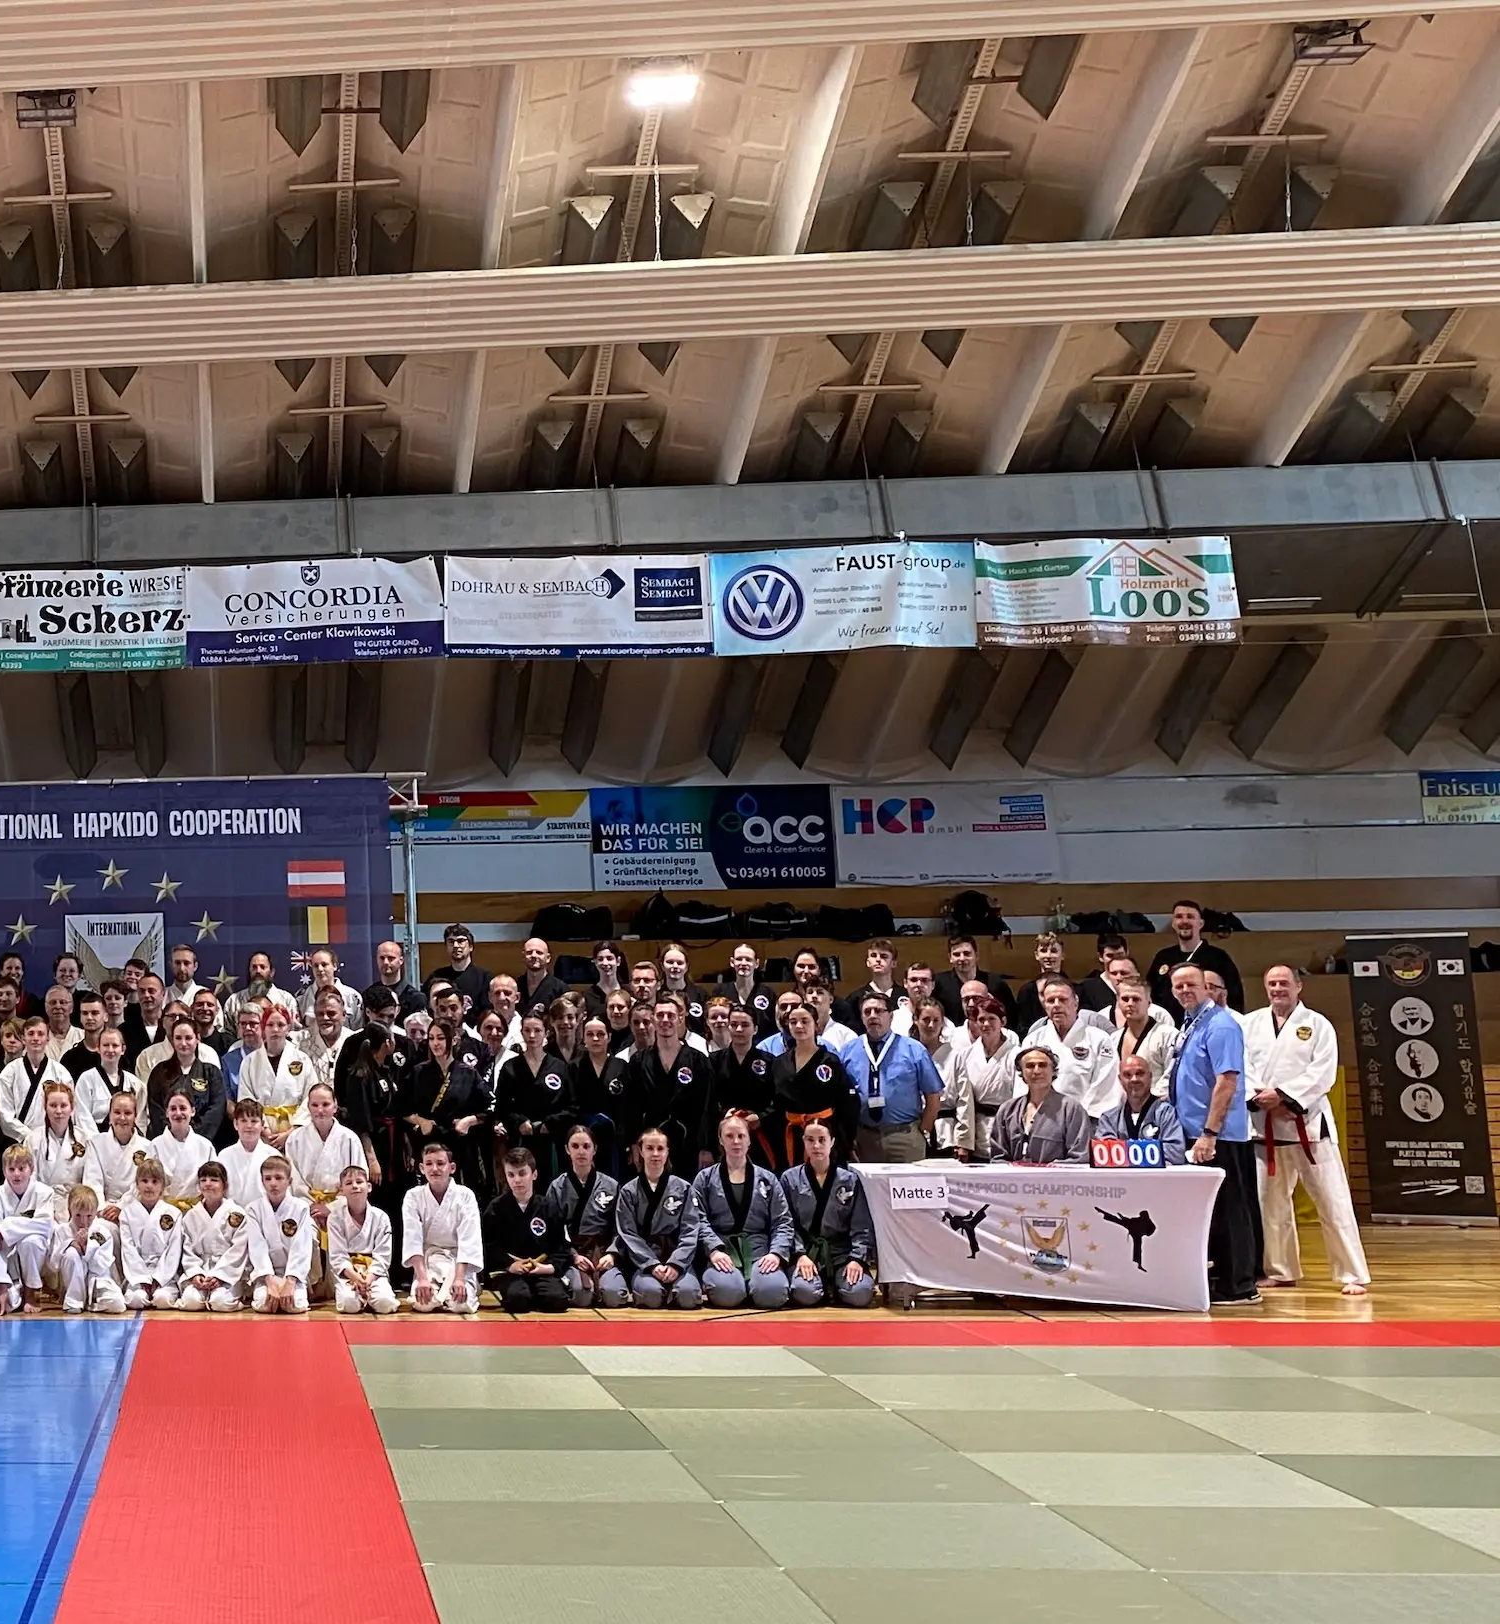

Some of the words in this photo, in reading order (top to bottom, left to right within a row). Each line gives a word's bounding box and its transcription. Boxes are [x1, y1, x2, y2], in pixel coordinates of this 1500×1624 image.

[1044, 564, 1069, 572] Garten
[451, 581, 515, 594] DOHRAU
[518, 583, 529, 594] &
[533, 580, 605, 594] SEMBACH
[641, 576, 694, 587] SEMBACH
[1121, 578, 1189, 589] Holzmarkt
[641, 587, 694, 598] SEMBACH
[224, 585, 403, 613] CONCORDIA
[39, 604, 185, 634] Scherz
[225, 606, 405, 626] Versicherungen
[838, 627, 859, 638] Wir
[860, 624, 891, 638] freuen
[895, 625, 909, 633] uns
[925, 622, 944, 635] Sie!
[1032, 627, 1042, 635] 26
[1145, 624, 1176, 632] Telefon
[42, 637, 92, 647] PARFÜMERIE
[100, 637, 139, 646] KOSMETIK
[147, 635, 185, 645] WELLNESS
[235, 632, 275, 644] Service
[284, 631, 323, 642] Center
[326, 626, 396, 639] Klawikowski
[1179, 633, 1203, 641] 03491
[419, 646, 433, 654] 347
[451, 647, 561, 656] www.dohrau-sembach.de
[842, 798, 935, 834] HCP
[73, 810, 159, 838] HAPKIDO
[169, 807, 301, 836] COOPERATION
[600, 824, 631, 836] WIR
[635, 822, 703, 836] MACHEN
[743, 814, 825, 845] acc
[601, 839, 633, 851] DAS
[638, 837, 668, 850] FÜR
[675, 837, 703, 850] SIE!
[798, 845, 826, 853] Service
[612, 857, 696, 867] Gebäudereinigung
[613, 867, 699, 877] Grünflächenpflege
[739, 867, 777, 878] 03491
[780, 866, 827, 878] 610005
[613, 878, 703, 886] Hausmeisterservice
[87, 919, 142, 937] INTERNATIONAL
[1093, 1143, 1125, 1165] 00
[1128, 1143, 1160, 1165] 00
[893, 1187, 933, 1199] Matte
[937, 1187, 945, 1199] 3
[1023, 1183, 1127, 1198] CHAMPIONSHIP
